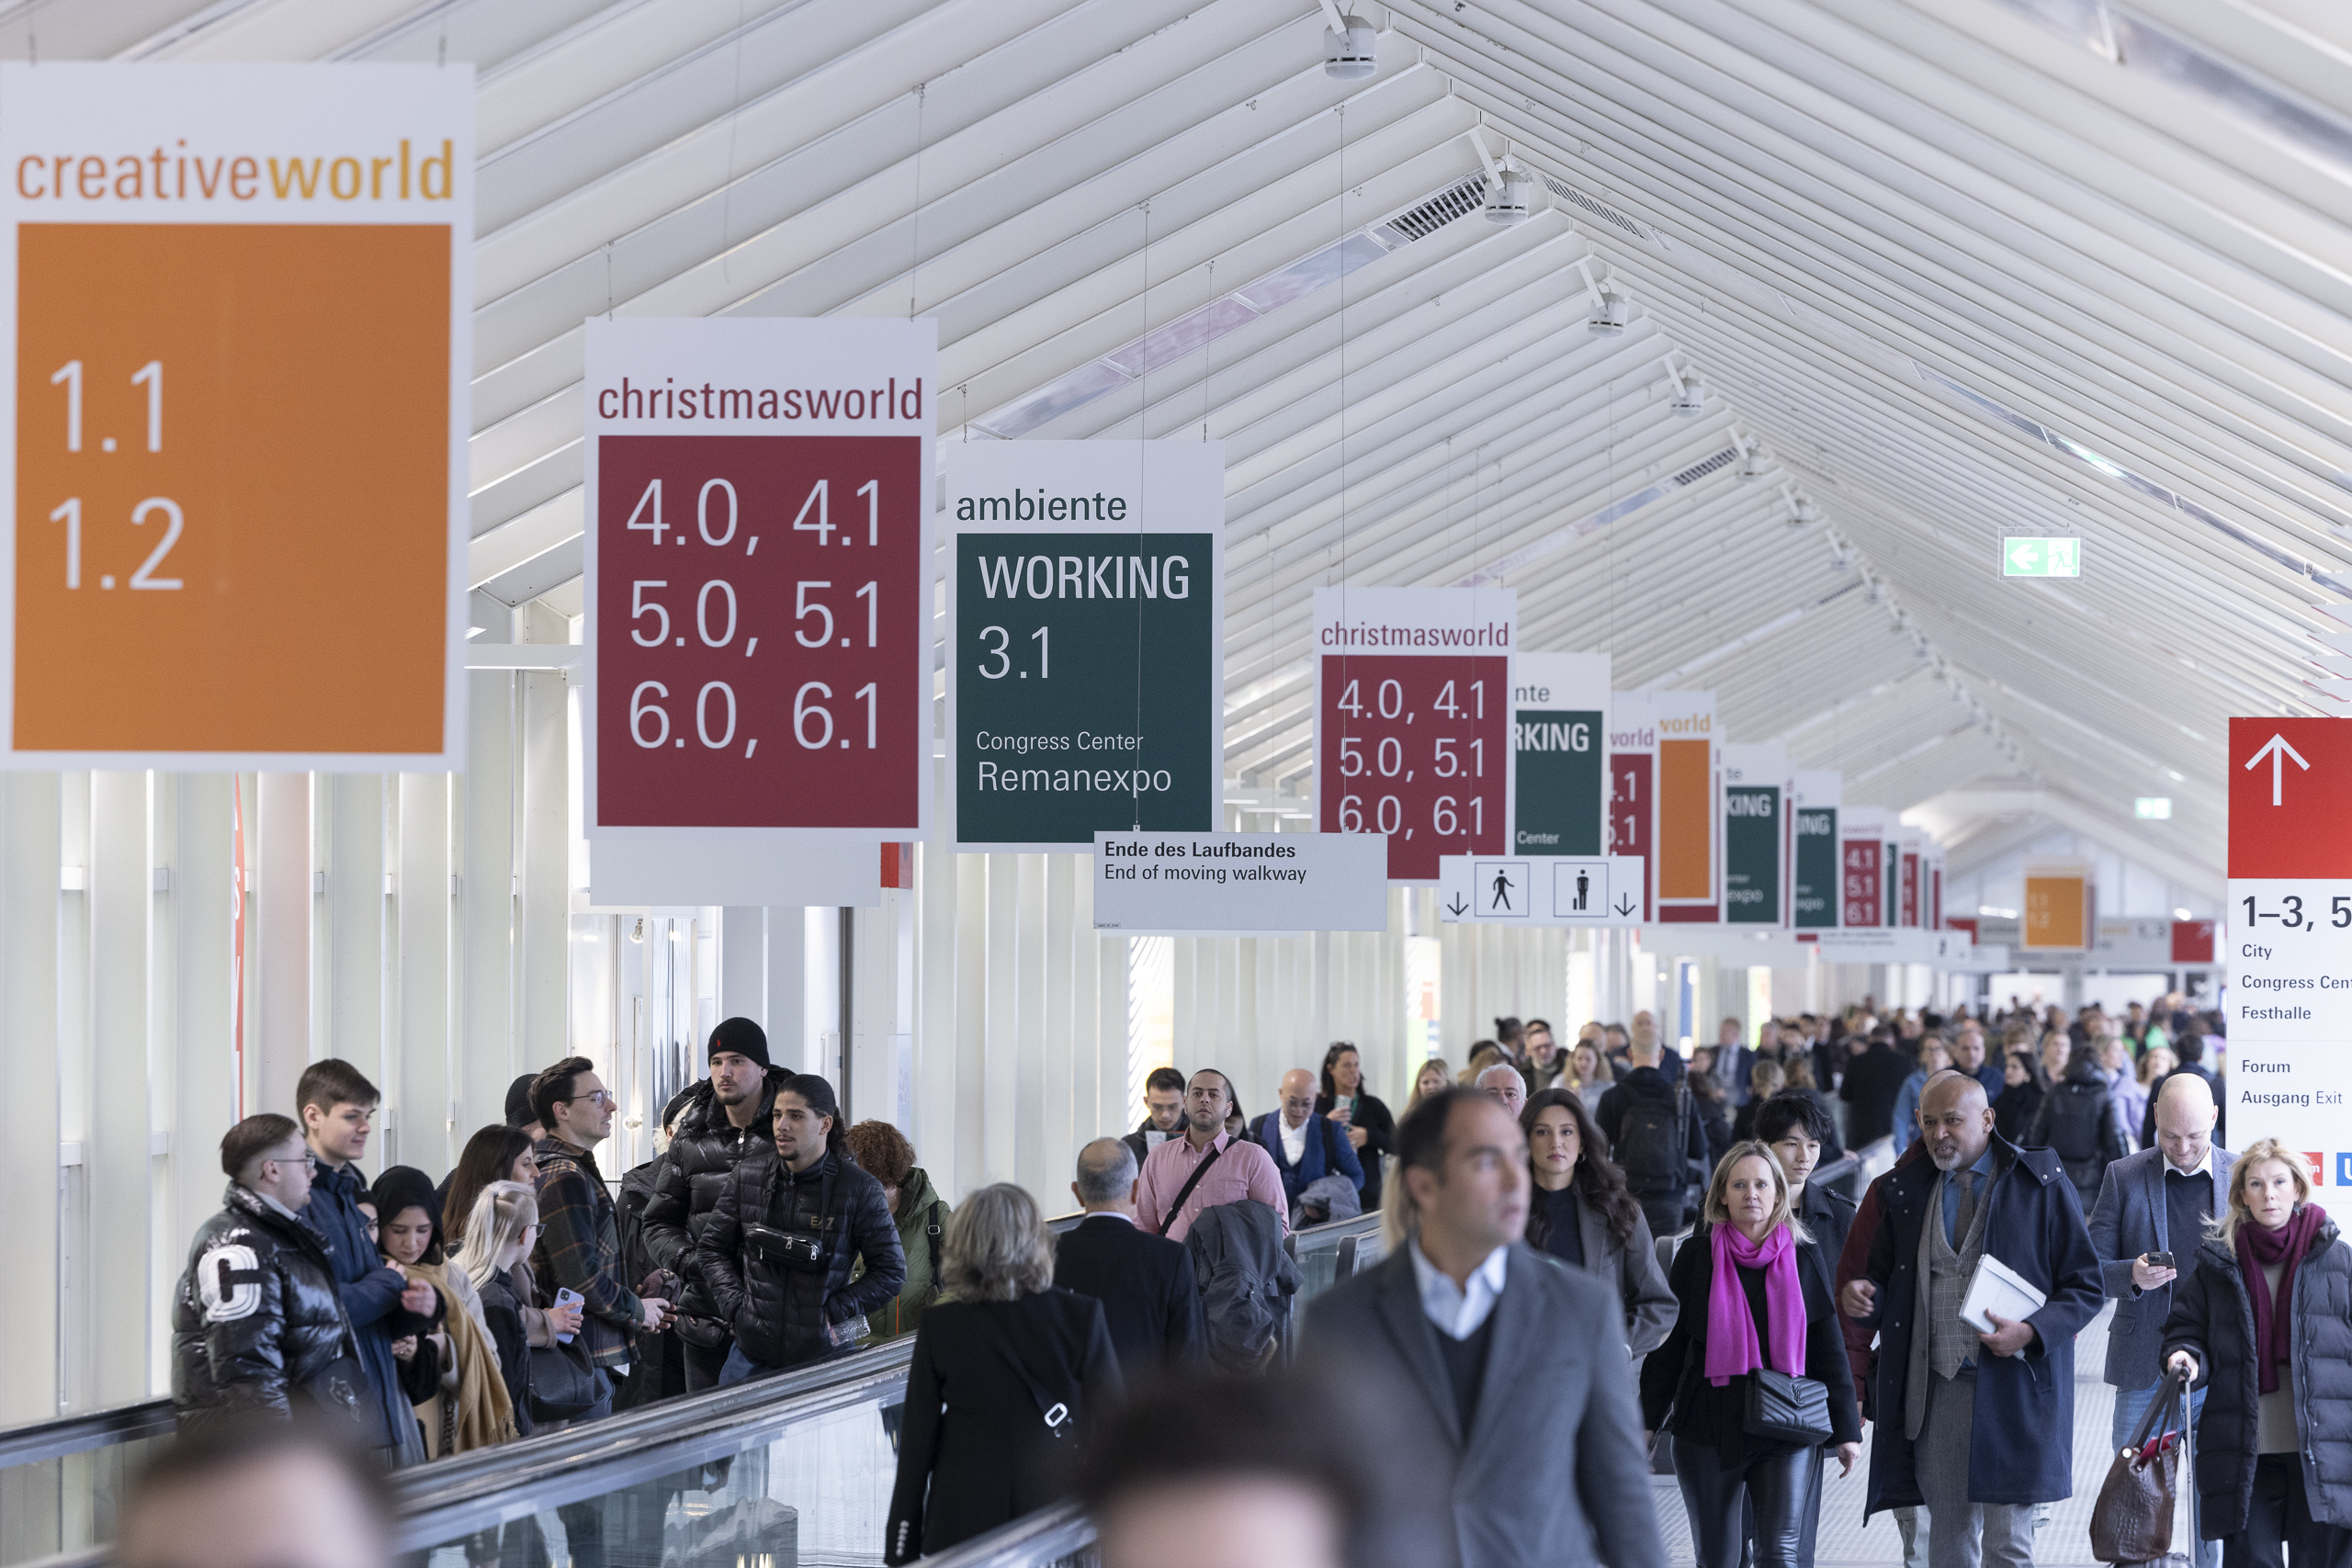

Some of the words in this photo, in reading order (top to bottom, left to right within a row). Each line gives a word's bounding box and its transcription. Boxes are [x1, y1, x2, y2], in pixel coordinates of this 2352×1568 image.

[17, 139, 453, 200] creativeworld
[51, 360, 162, 452] 1.1
[599, 378, 922, 420] christmasworld
[628, 479, 759, 556] 4.0,
[793, 479, 878, 546] 4.1
[956, 489, 1126, 521] ambiente
[51, 497, 184, 590] 1.2
[978, 556, 1189, 599] WORKING
[631, 580, 758, 657] 5.0,
[795, 581, 877, 648] 5.1
[1321, 621, 1508, 647] christmasworld
[978, 626, 1047, 679] 3.1
[630, 681, 757, 758] 6.0,
[794, 682, 876, 750] 6.1
[1338, 679, 1414, 724] 4.0,
[1433, 680, 1483, 719] 4.1
[977, 731, 1069, 754] Congress
[1077, 731, 1143, 750] Center
[1340, 737, 1414, 783] 5.0,
[1435, 739, 1483, 777] 5.1
[978, 761, 1171, 798] Remanexpo
[1339, 795, 1414, 840] 6.0,
[1433, 795, 1482, 835] 6.1
[1105, 841, 1148, 856] Ende
[1155, 841, 1185, 857] des
[1193, 842, 1295, 858] Laufbandes
[1517, 830, 1560, 845] Center
[1105, 864, 1136, 879] End
[1142, 864, 1159, 879] of
[1165, 865, 1226, 885] moving
[1233, 865, 1306, 884] walkway
[2243, 944, 2272, 960] City
[2242, 975, 2314, 991] Congress
[2320, 975, 2352, 989] Cen
[2243, 1006, 2311, 1020] Festhalle
[2243, 1059, 2290, 1073] Forum
[2242, 1090, 2309, 1107] Ausgang
[2316, 1090, 2342, 1104] Exit
